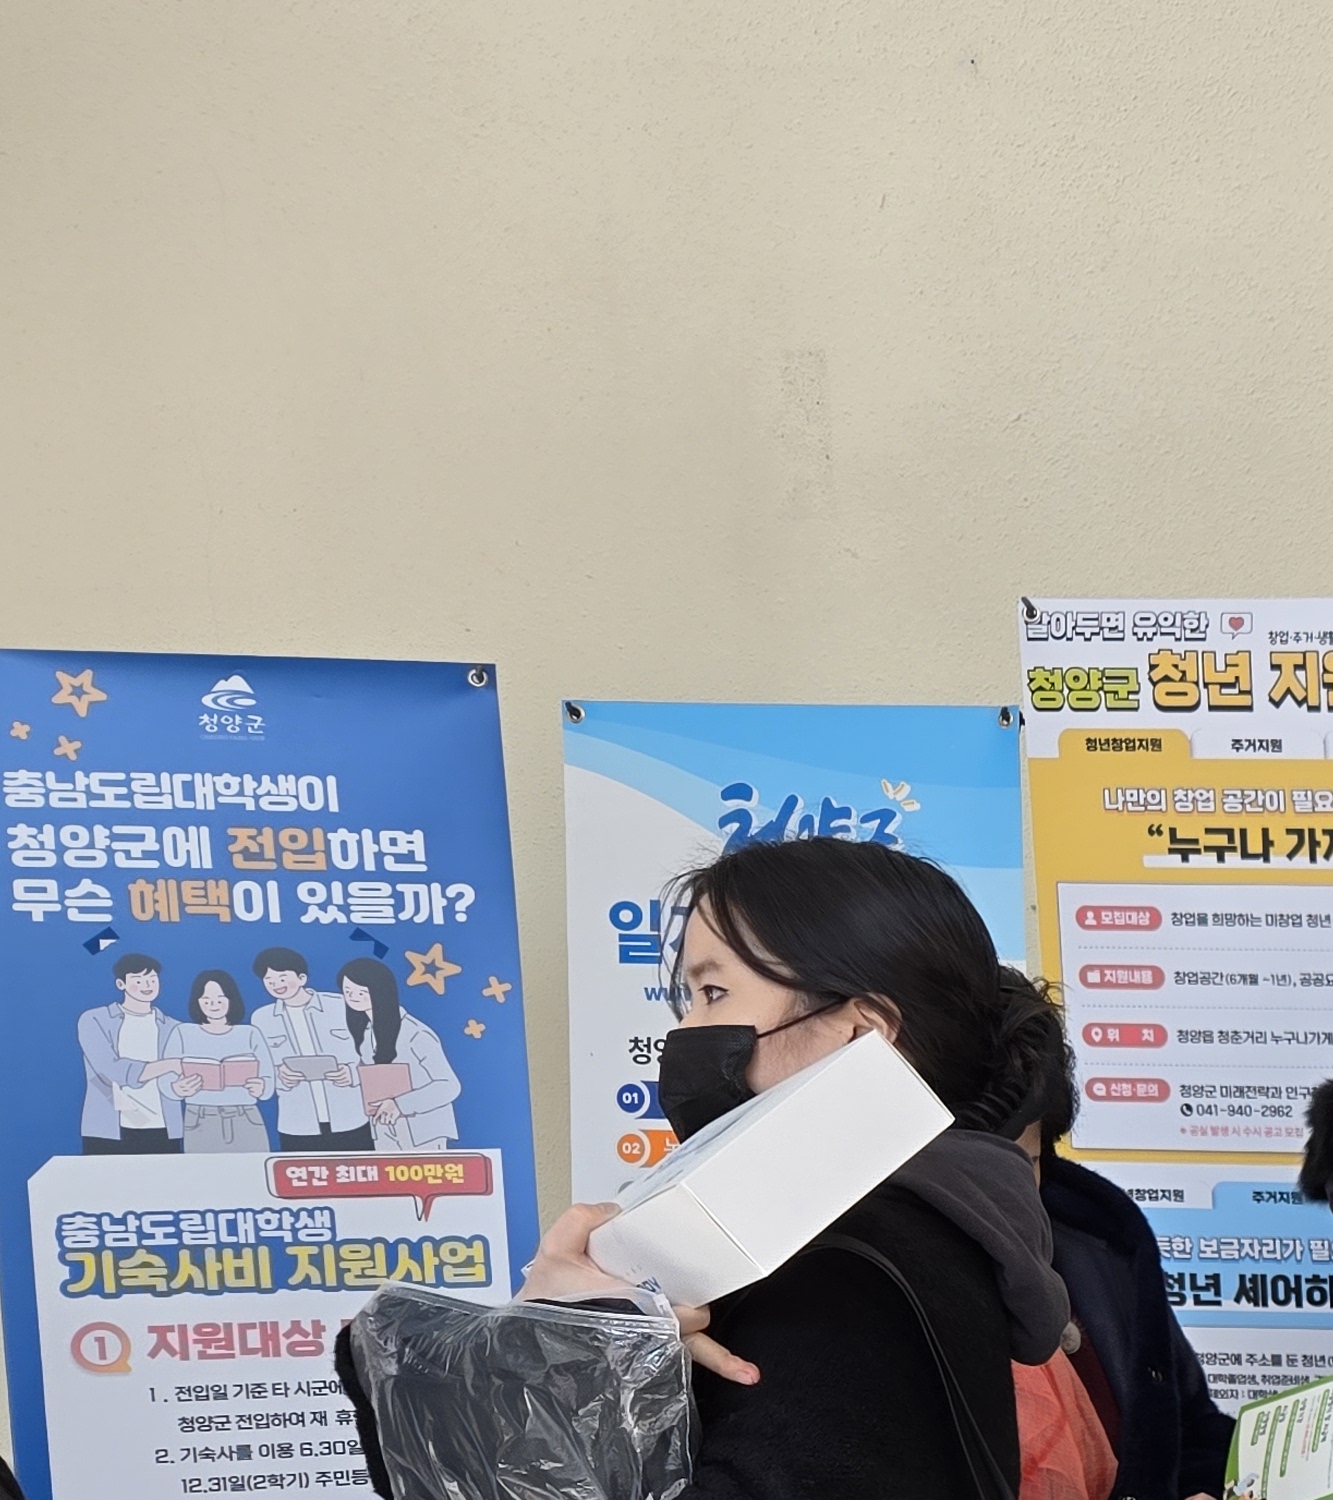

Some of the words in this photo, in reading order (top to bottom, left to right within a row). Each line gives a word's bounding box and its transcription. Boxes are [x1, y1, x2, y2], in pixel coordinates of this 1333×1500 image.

[1132, 611, 1209, 642] 유익한
[1027, 667, 1140, 710] 청양군
[1149, 650, 1254, 712] 청년
[199, 713, 266, 734] 청양군
[1085, 737, 1162, 753] 청년창업지원
[1231, 738, 1282, 753] 주거지원
[2, 770, 339, 812] 충남도립대학생이
[1104, 789, 1167, 813] 나만의
[1173, 789, 1215, 813] 창업
[1223, 790, 1286, 813] 공간이
[7, 824, 213, 868] 청양군에
[227, 826, 427, 872] 전입하면
[12, 878, 113, 923] 무슨
[128, 878, 281, 924] 혜택이
[297, 881, 476, 925] 있을까?
[1171, 912, 1208, 927] 창업을
[1212, 913, 1262, 928] 희망하는
[1265, 914, 1302, 927] 미창업
[1177, 1030, 1214, 1044] 청양읍
[1217, 1030, 1267, 1045] 청춘거리
[1271, 1031, 1333, 1045] 누구나가게
[623, 1092, 638, 1103] 01
[1180, 1085, 1217, 1099] 청양군
[1220, 1086, 1282, 1100] 미래전략과
[1285, 1087, 1317, 1100] 인구
[1196, 1104, 1293, 1118] 041-940-2962
[623, 1142, 641, 1154] 02
[286, 1165, 329, 1186] 연간
[336, 1164, 378, 1183] 최대
[384, 1164, 465, 1184] 100만원
[61, 1211, 332, 1248] 충남도립대학생
[1200, 1237, 1302, 1260] 보금자리가
[65, 1245, 272, 1294] 기숙사비
[288, 1241, 487, 1286] 지원사업
[93, 1336, 107, 1360] 1
[147, 1320, 325, 1362] 지원대상
[1246, 1354, 1282, 1367] 주소를
[1286, 1354, 1298, 1367] 둔
[175, 1385, 228, 1401] 전입일
[233, 1383, 268, 1399] 기준
[272, 1382, 289, 1398] 타
[178, 1415, 231, 1433] 청양군
[235, 1412, 306, 1430] 전입하여
[310, 1411, 328, 1427] 재
[180, 1445, 253, 1463] 기숙사를
[259, 1442, 294, 1459] 이용
[181, 1473, 309, 1493] 12.31일(2학기)
